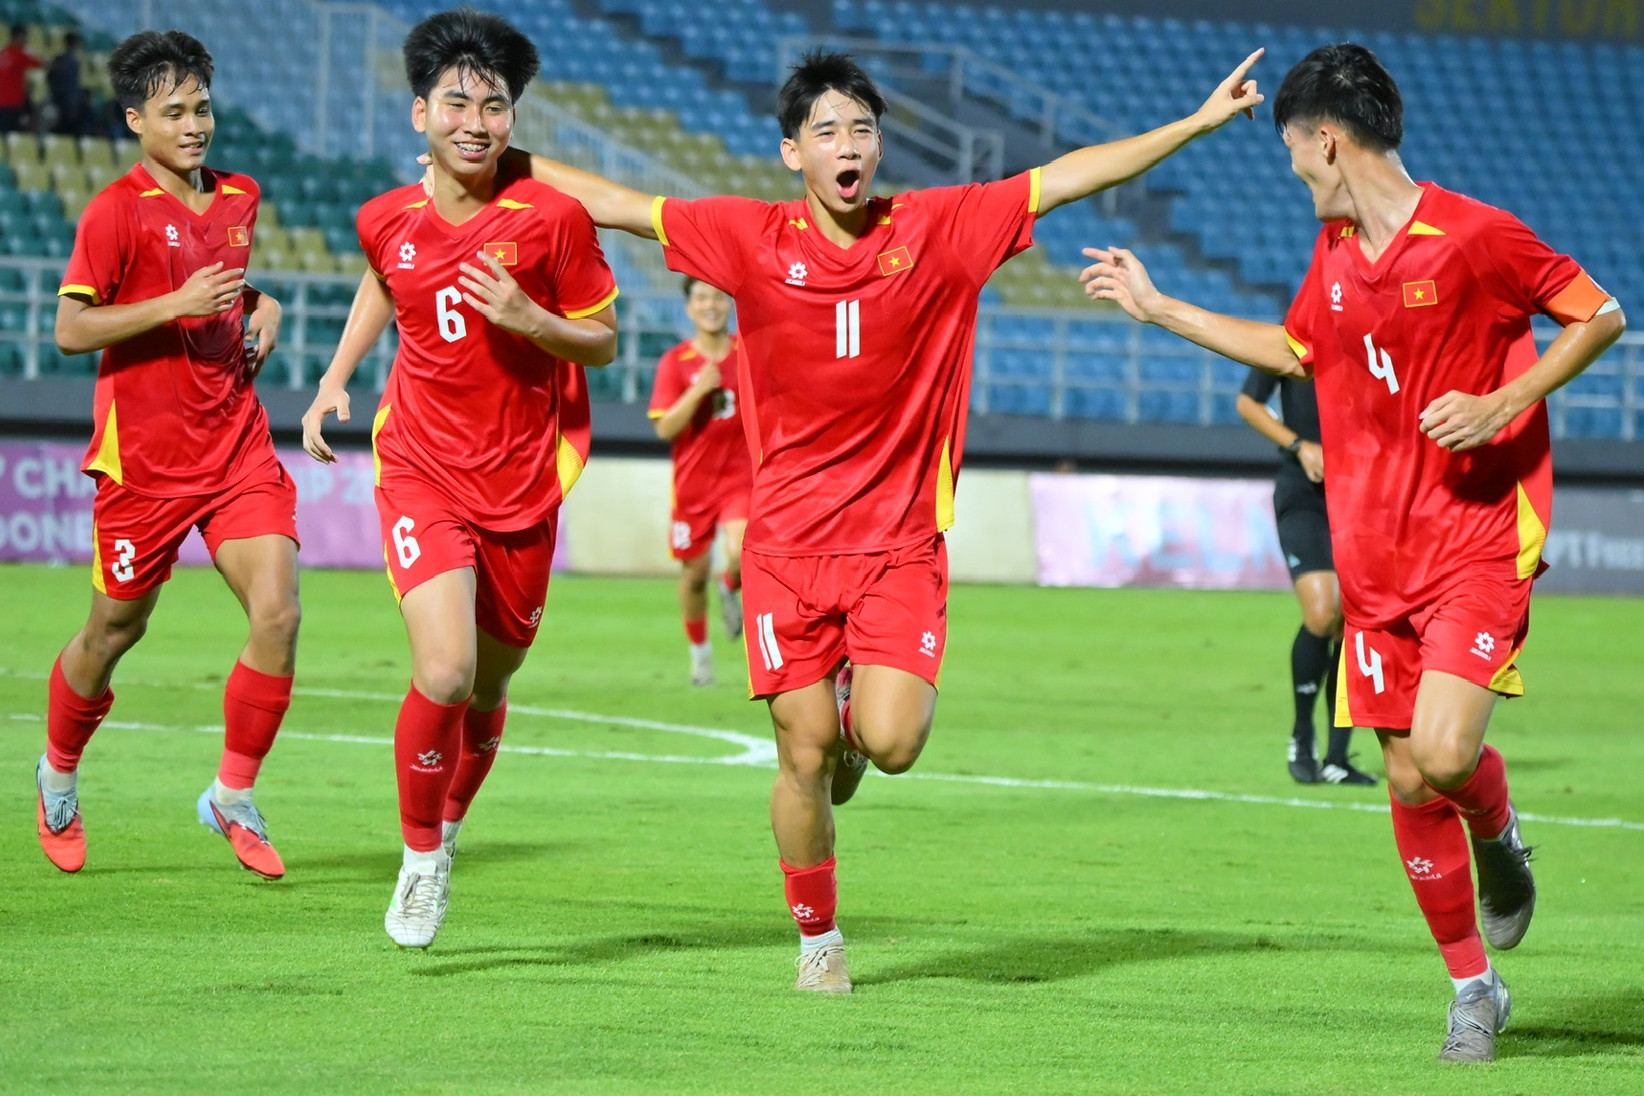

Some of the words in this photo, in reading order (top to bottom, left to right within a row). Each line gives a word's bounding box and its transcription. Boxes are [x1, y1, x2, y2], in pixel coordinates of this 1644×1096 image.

[435, 285, 467, 343] 6
[836, 299, 860, 359] 11
[1363, 333, 1400, 395] 4
[111, 538, 136, 582] 3
[392, 515, 421, 570] 6
[756, 612, 784, 671] 11
[1355, 631, 1385, 695] 4
